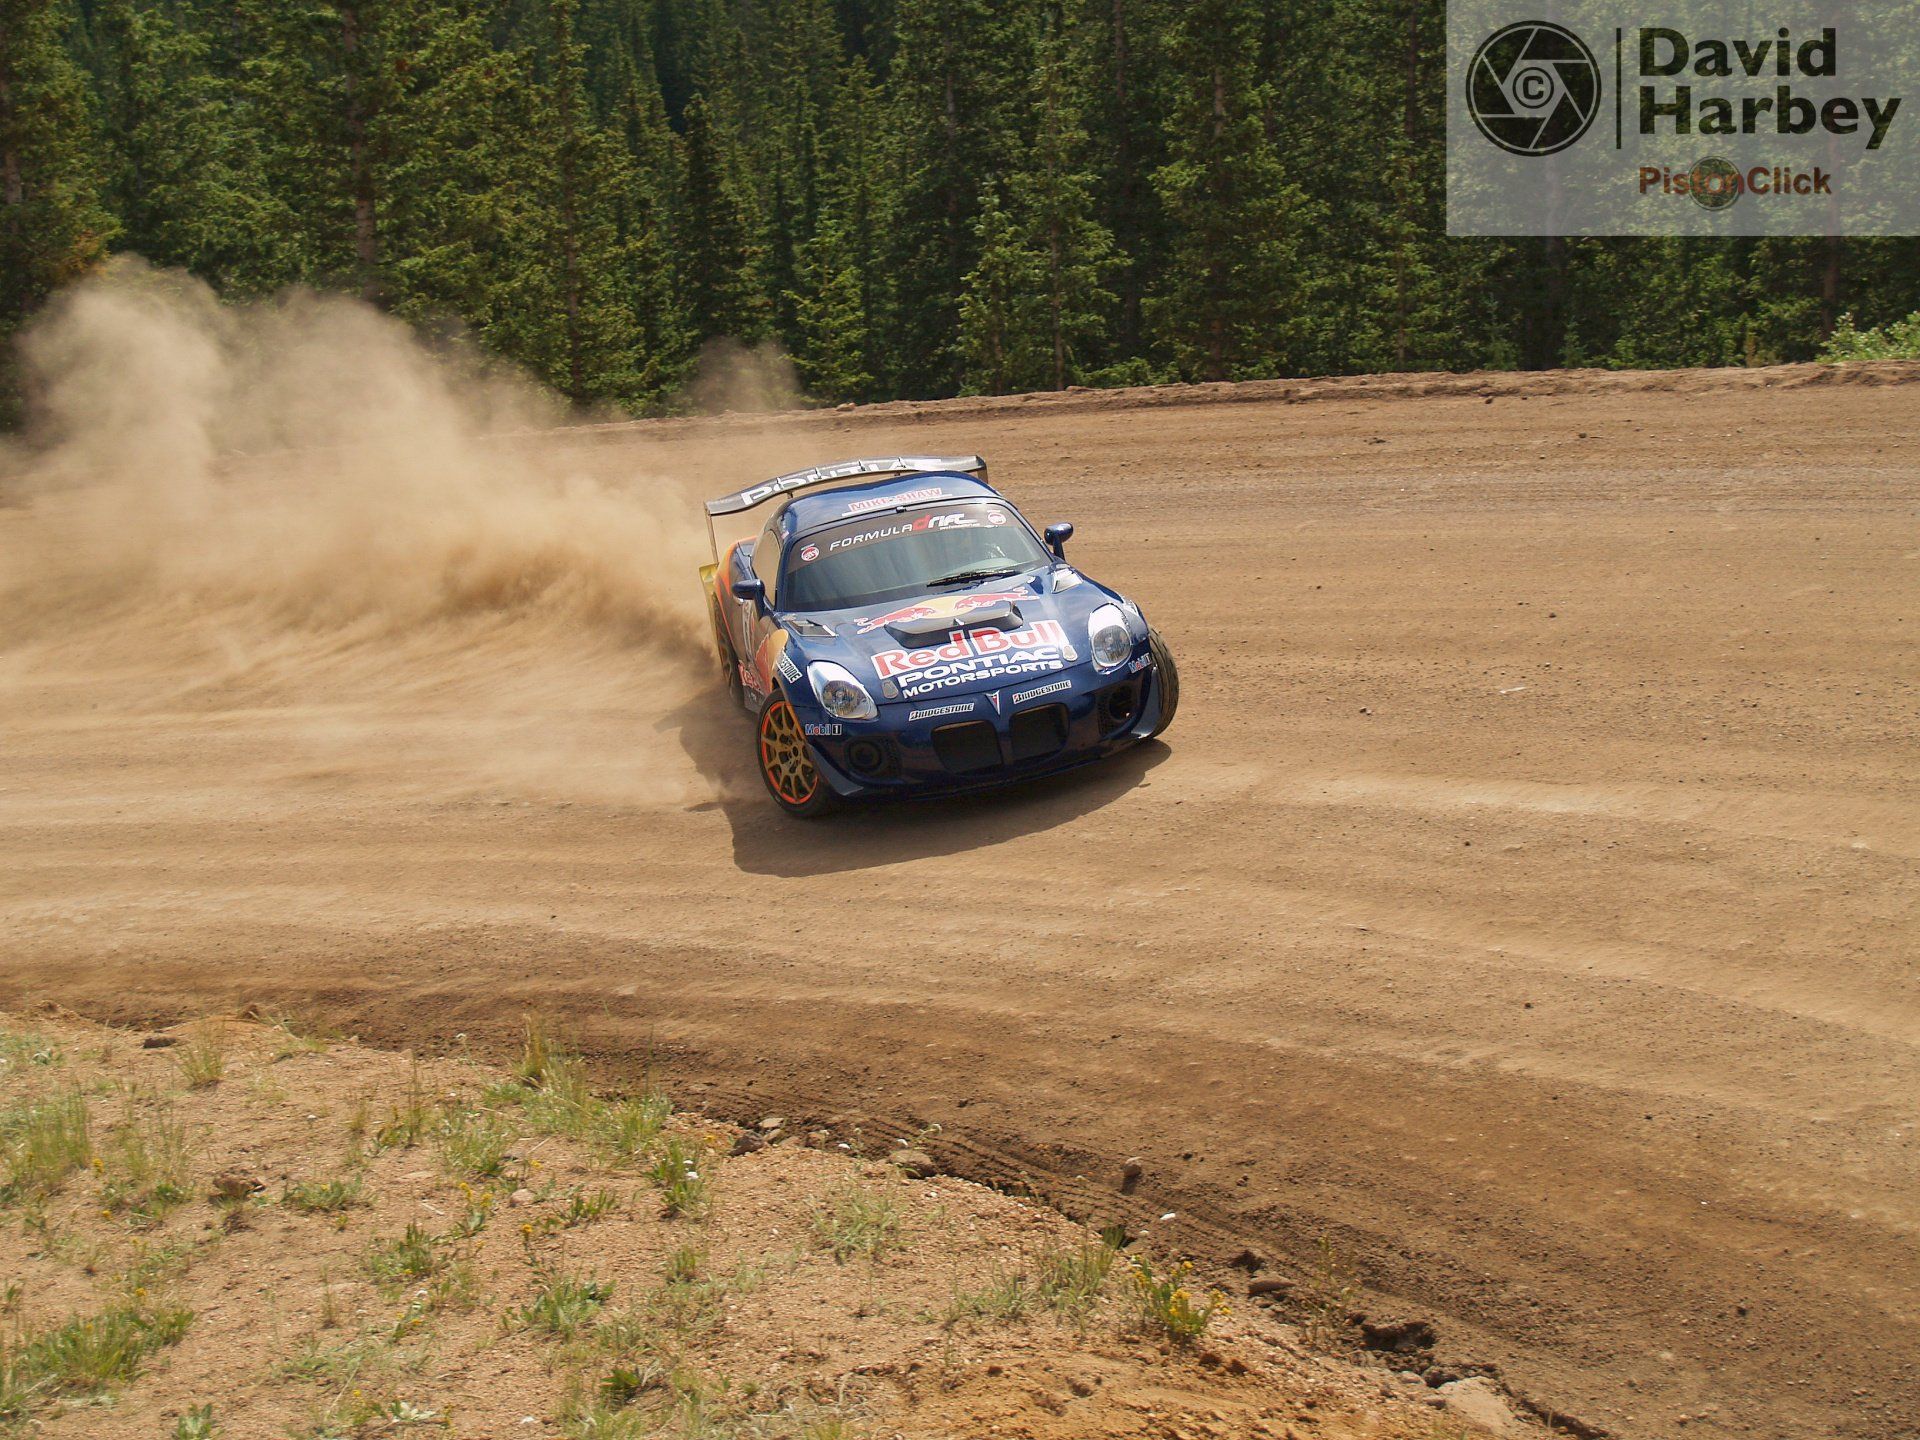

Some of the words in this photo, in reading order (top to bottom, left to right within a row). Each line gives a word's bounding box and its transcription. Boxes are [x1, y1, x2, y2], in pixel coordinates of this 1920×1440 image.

[829, 523, 912, 550] FORMULA
[873, 630, 971, 678] Red
[971, 621, 1066, 654] Bull
[897, 648, 1060, 687] PONTIAC
[903, 660, 1064, 698] MOTORSPORTS
[1013, 680, 1072, 704] BRIDGESTONE
[910, 703, 974, 721] BRIDGESTONE
